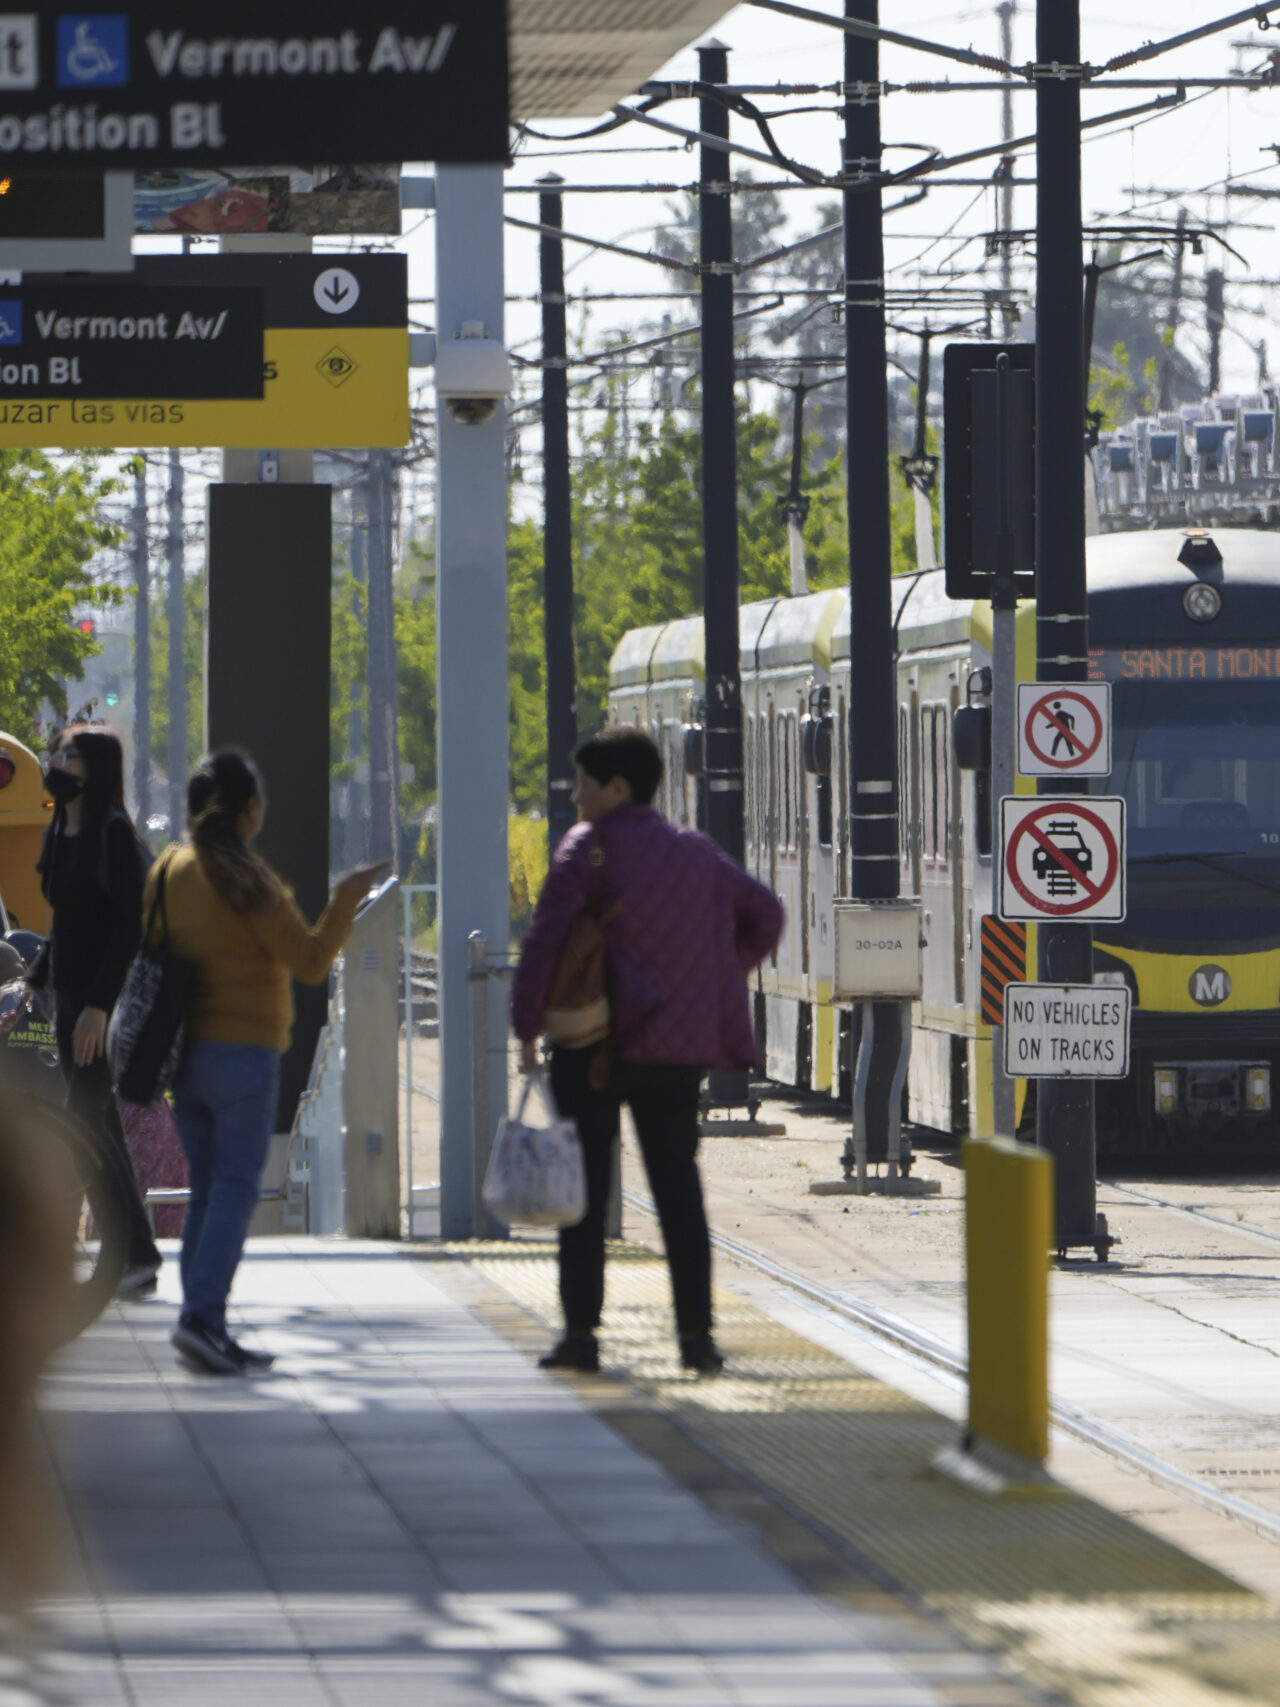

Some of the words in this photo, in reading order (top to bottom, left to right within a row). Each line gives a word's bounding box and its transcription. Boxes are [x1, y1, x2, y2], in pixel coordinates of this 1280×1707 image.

[146, 28, 362, 77] Vermont
[366, 22, 458, 75] Av/
[170, 101, 226, 150] Bl
[34, 309, 168, 340] Vermont
[174, 309, 230, 340] Av/
[0, 357, 39, 385] on
[49, 356, 82, 385] Bl
[70, 400, 116, 424] las
[1121, 648, 1207, 678] SANTA
[855, 939, 903, 951] 30-02A
[1013, 1000, 1035, 1023] NO
[1042, 1001, 1120, 1026] VEHICLES
[1018, 1037, 1041, 1061] ON
[1050, 1038, 1115, 1062] TRACKS
